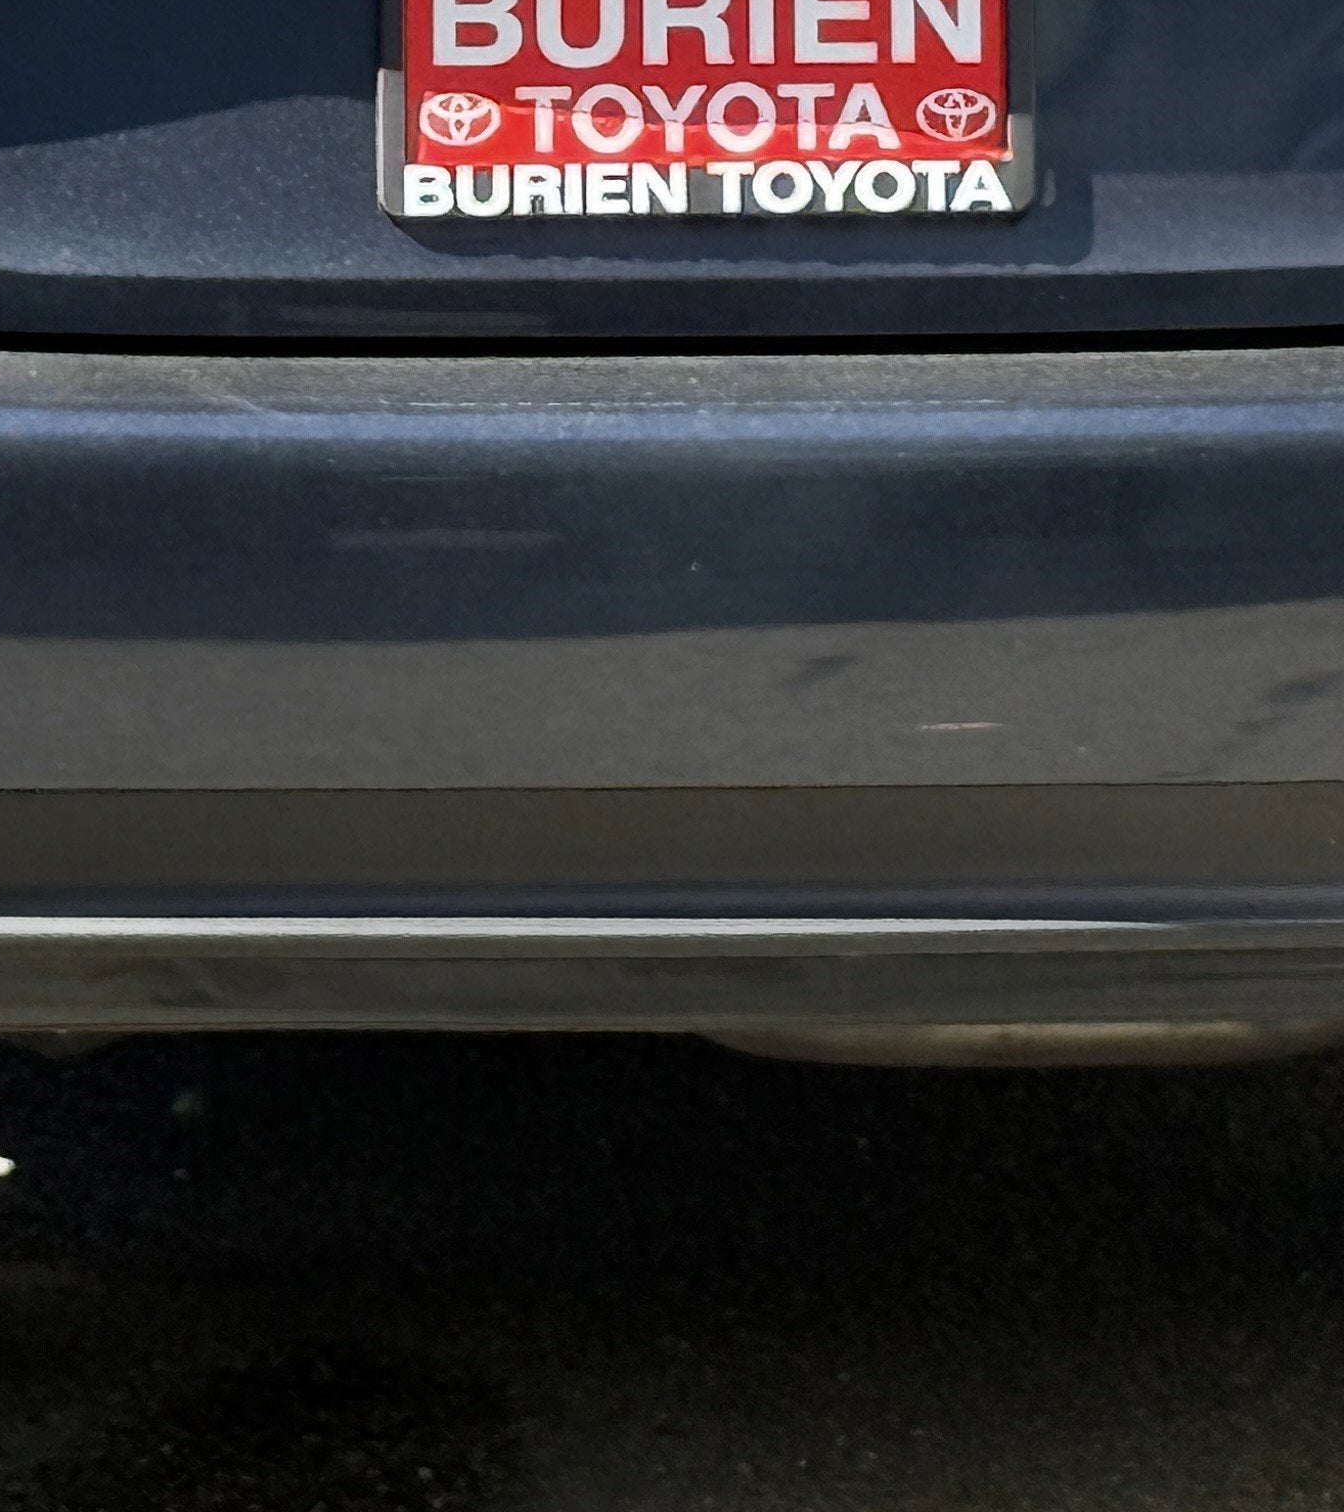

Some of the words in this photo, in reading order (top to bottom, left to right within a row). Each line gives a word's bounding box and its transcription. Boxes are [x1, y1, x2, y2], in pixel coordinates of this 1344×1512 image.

[514, 82, 901, 154] TOYOTA
[402, 162, 690, 218] BURIEN
[704, 159, 1014, 215] TOYOTA
